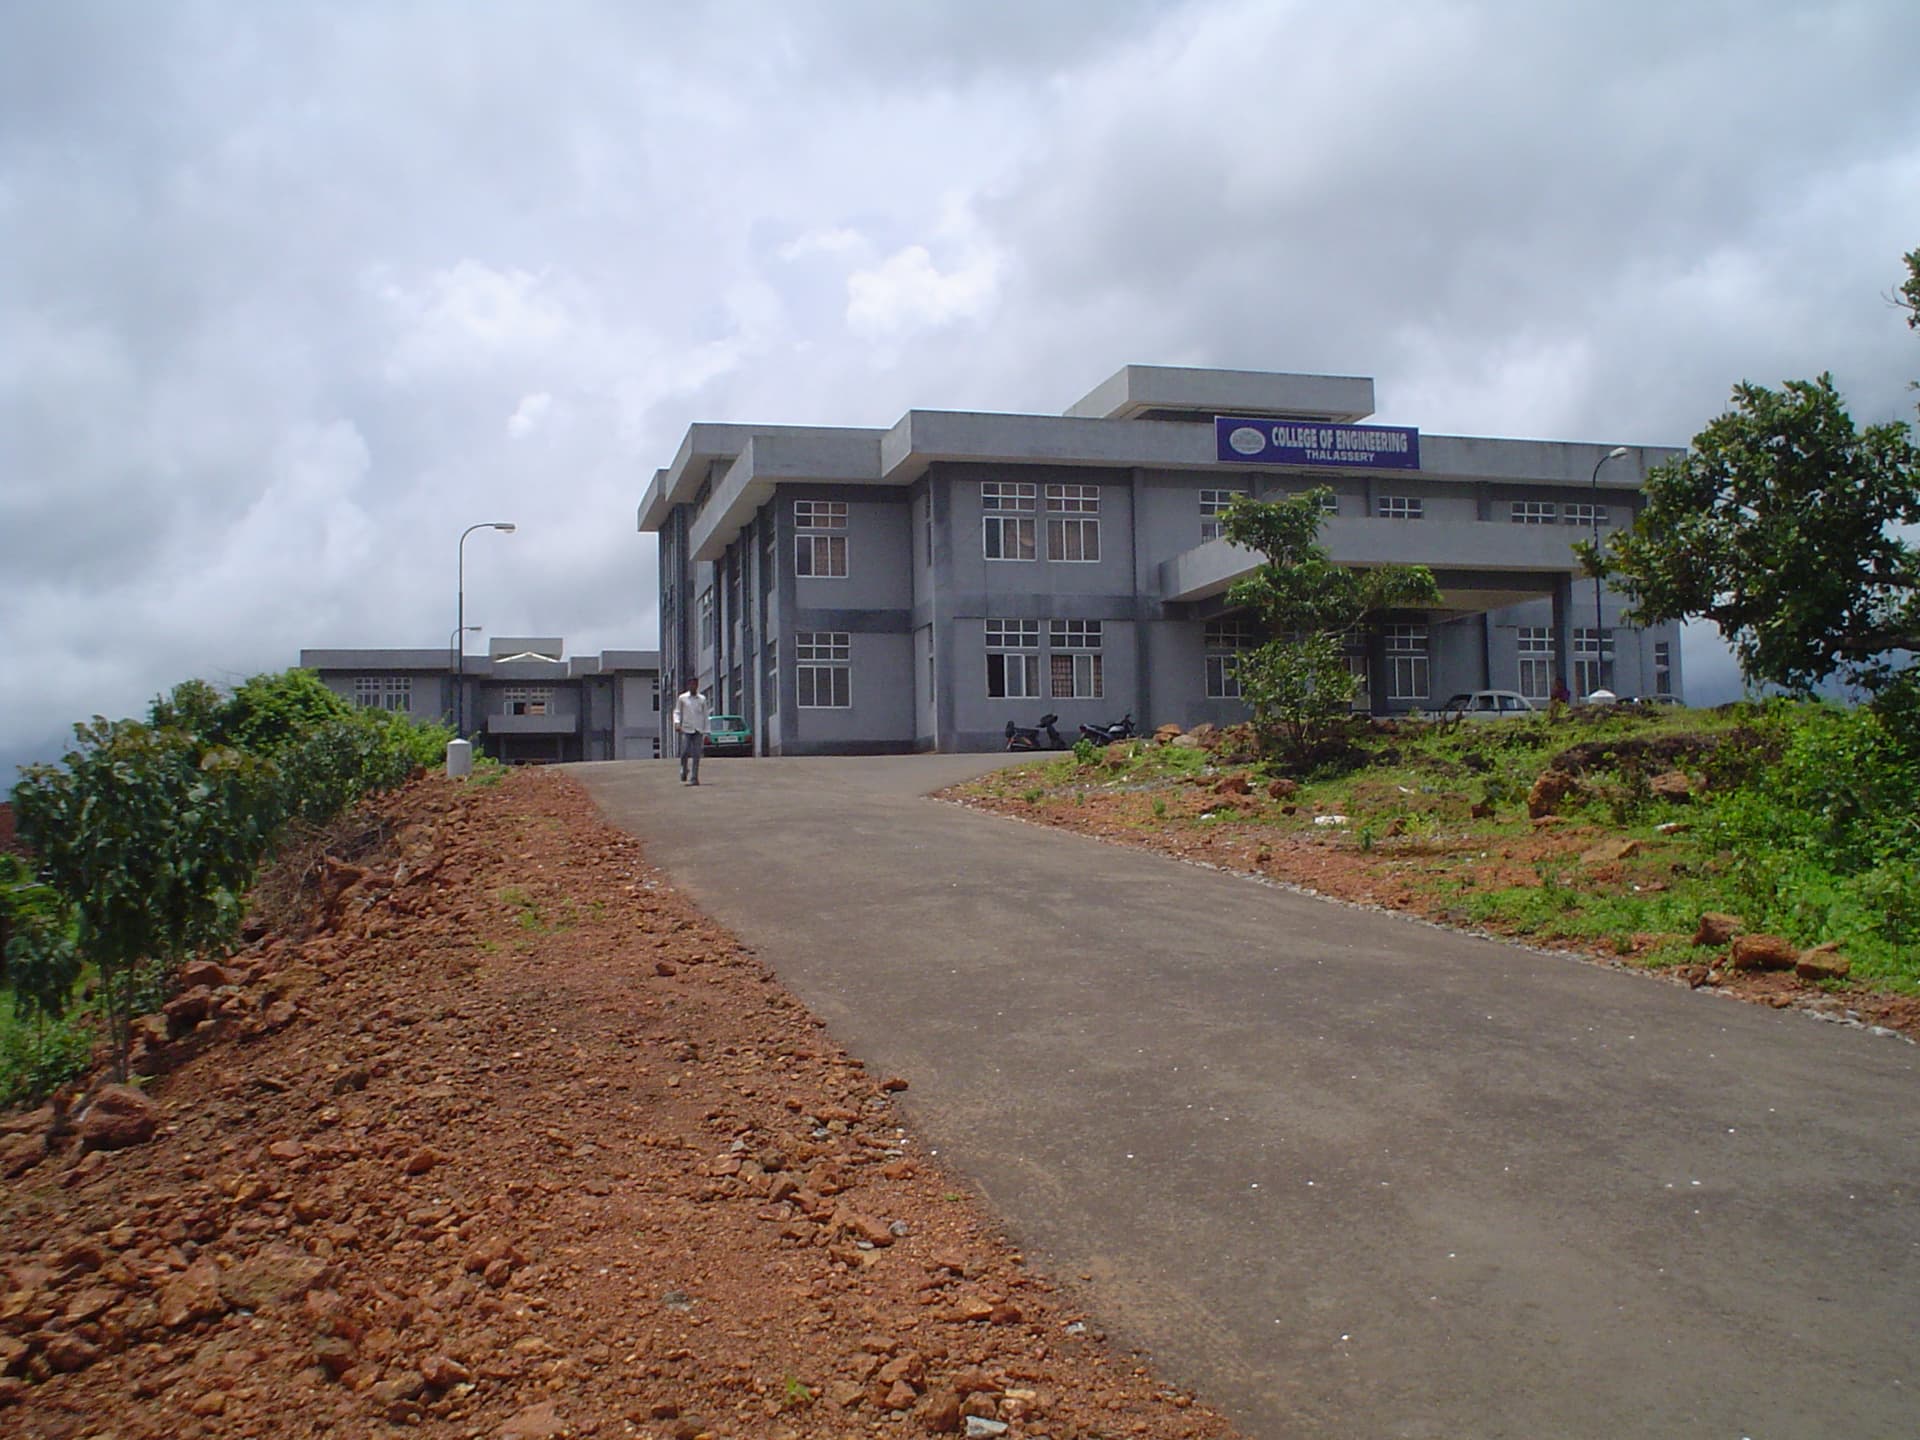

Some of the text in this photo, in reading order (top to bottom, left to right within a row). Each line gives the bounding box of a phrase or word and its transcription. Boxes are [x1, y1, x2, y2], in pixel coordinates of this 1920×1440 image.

[1272, 426, 1317, 448] COLLEGE
[1319, 429, 1334, 449] OF
[1336, 430, 1408, 453] ENGINEERING
[1305, 449, 1375, 462] THALASSERY
